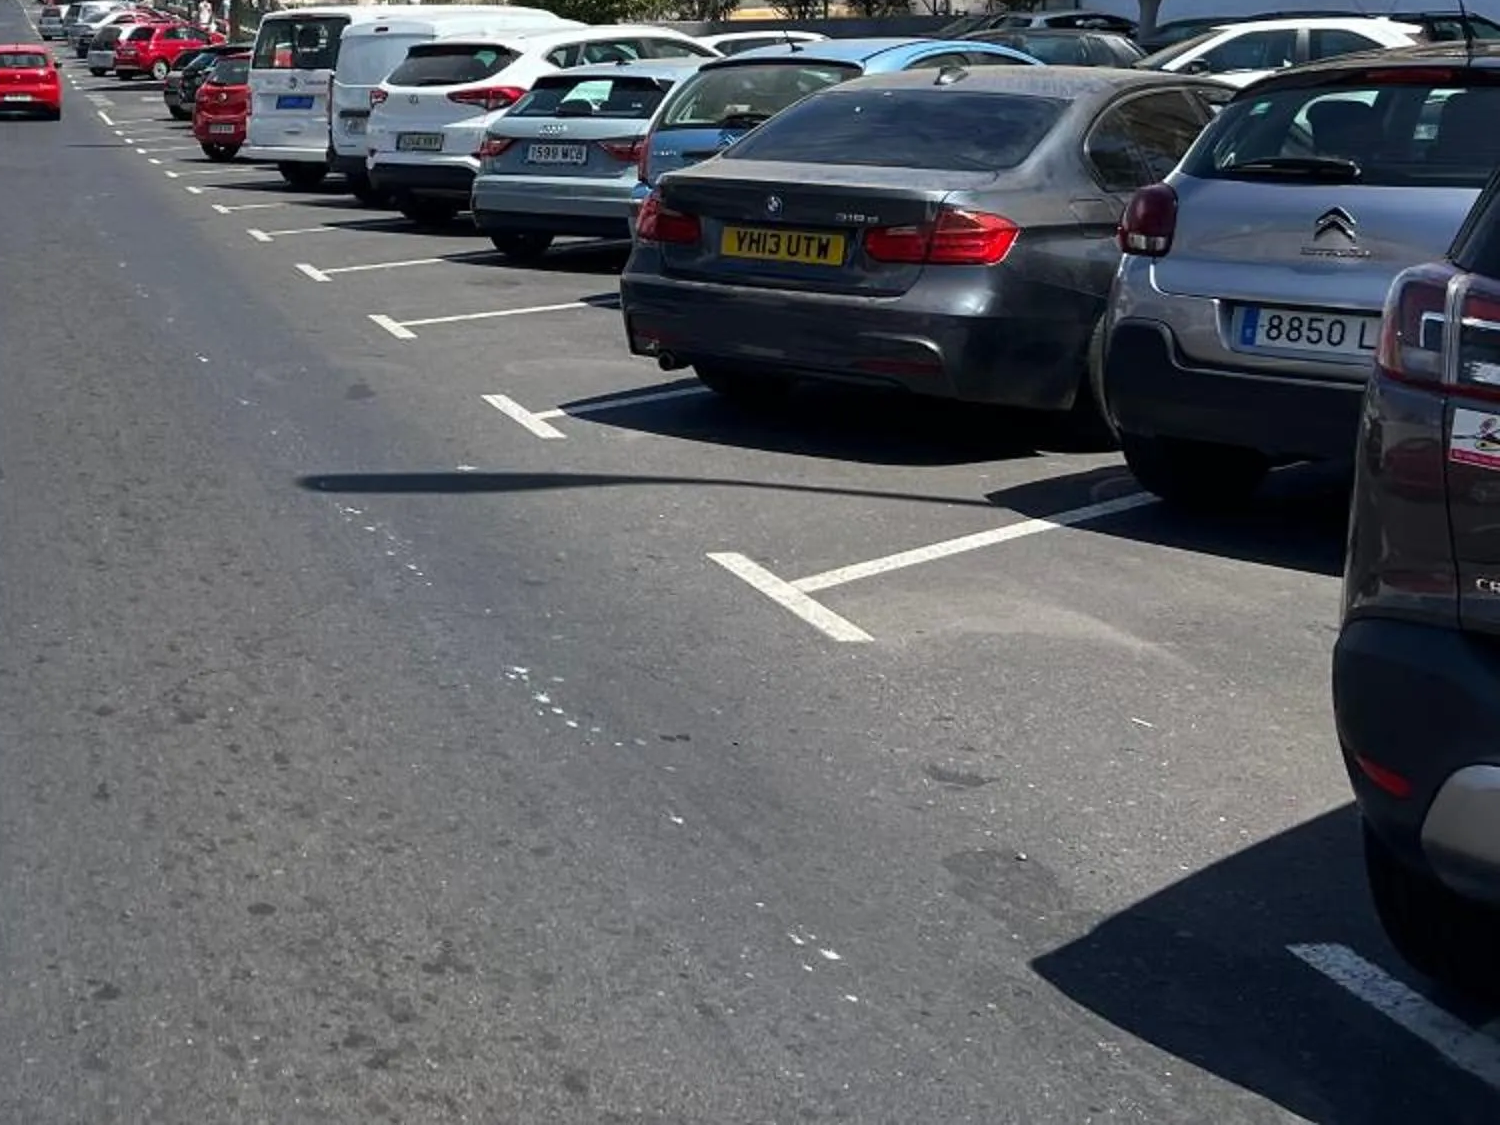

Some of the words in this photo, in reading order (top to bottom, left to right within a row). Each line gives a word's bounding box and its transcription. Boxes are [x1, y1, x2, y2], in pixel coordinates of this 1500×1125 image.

[736, 230, 781, 255] YH13
[786, 234, 832, 259] UTW
[1265, 314, 1346, 347] 8850
